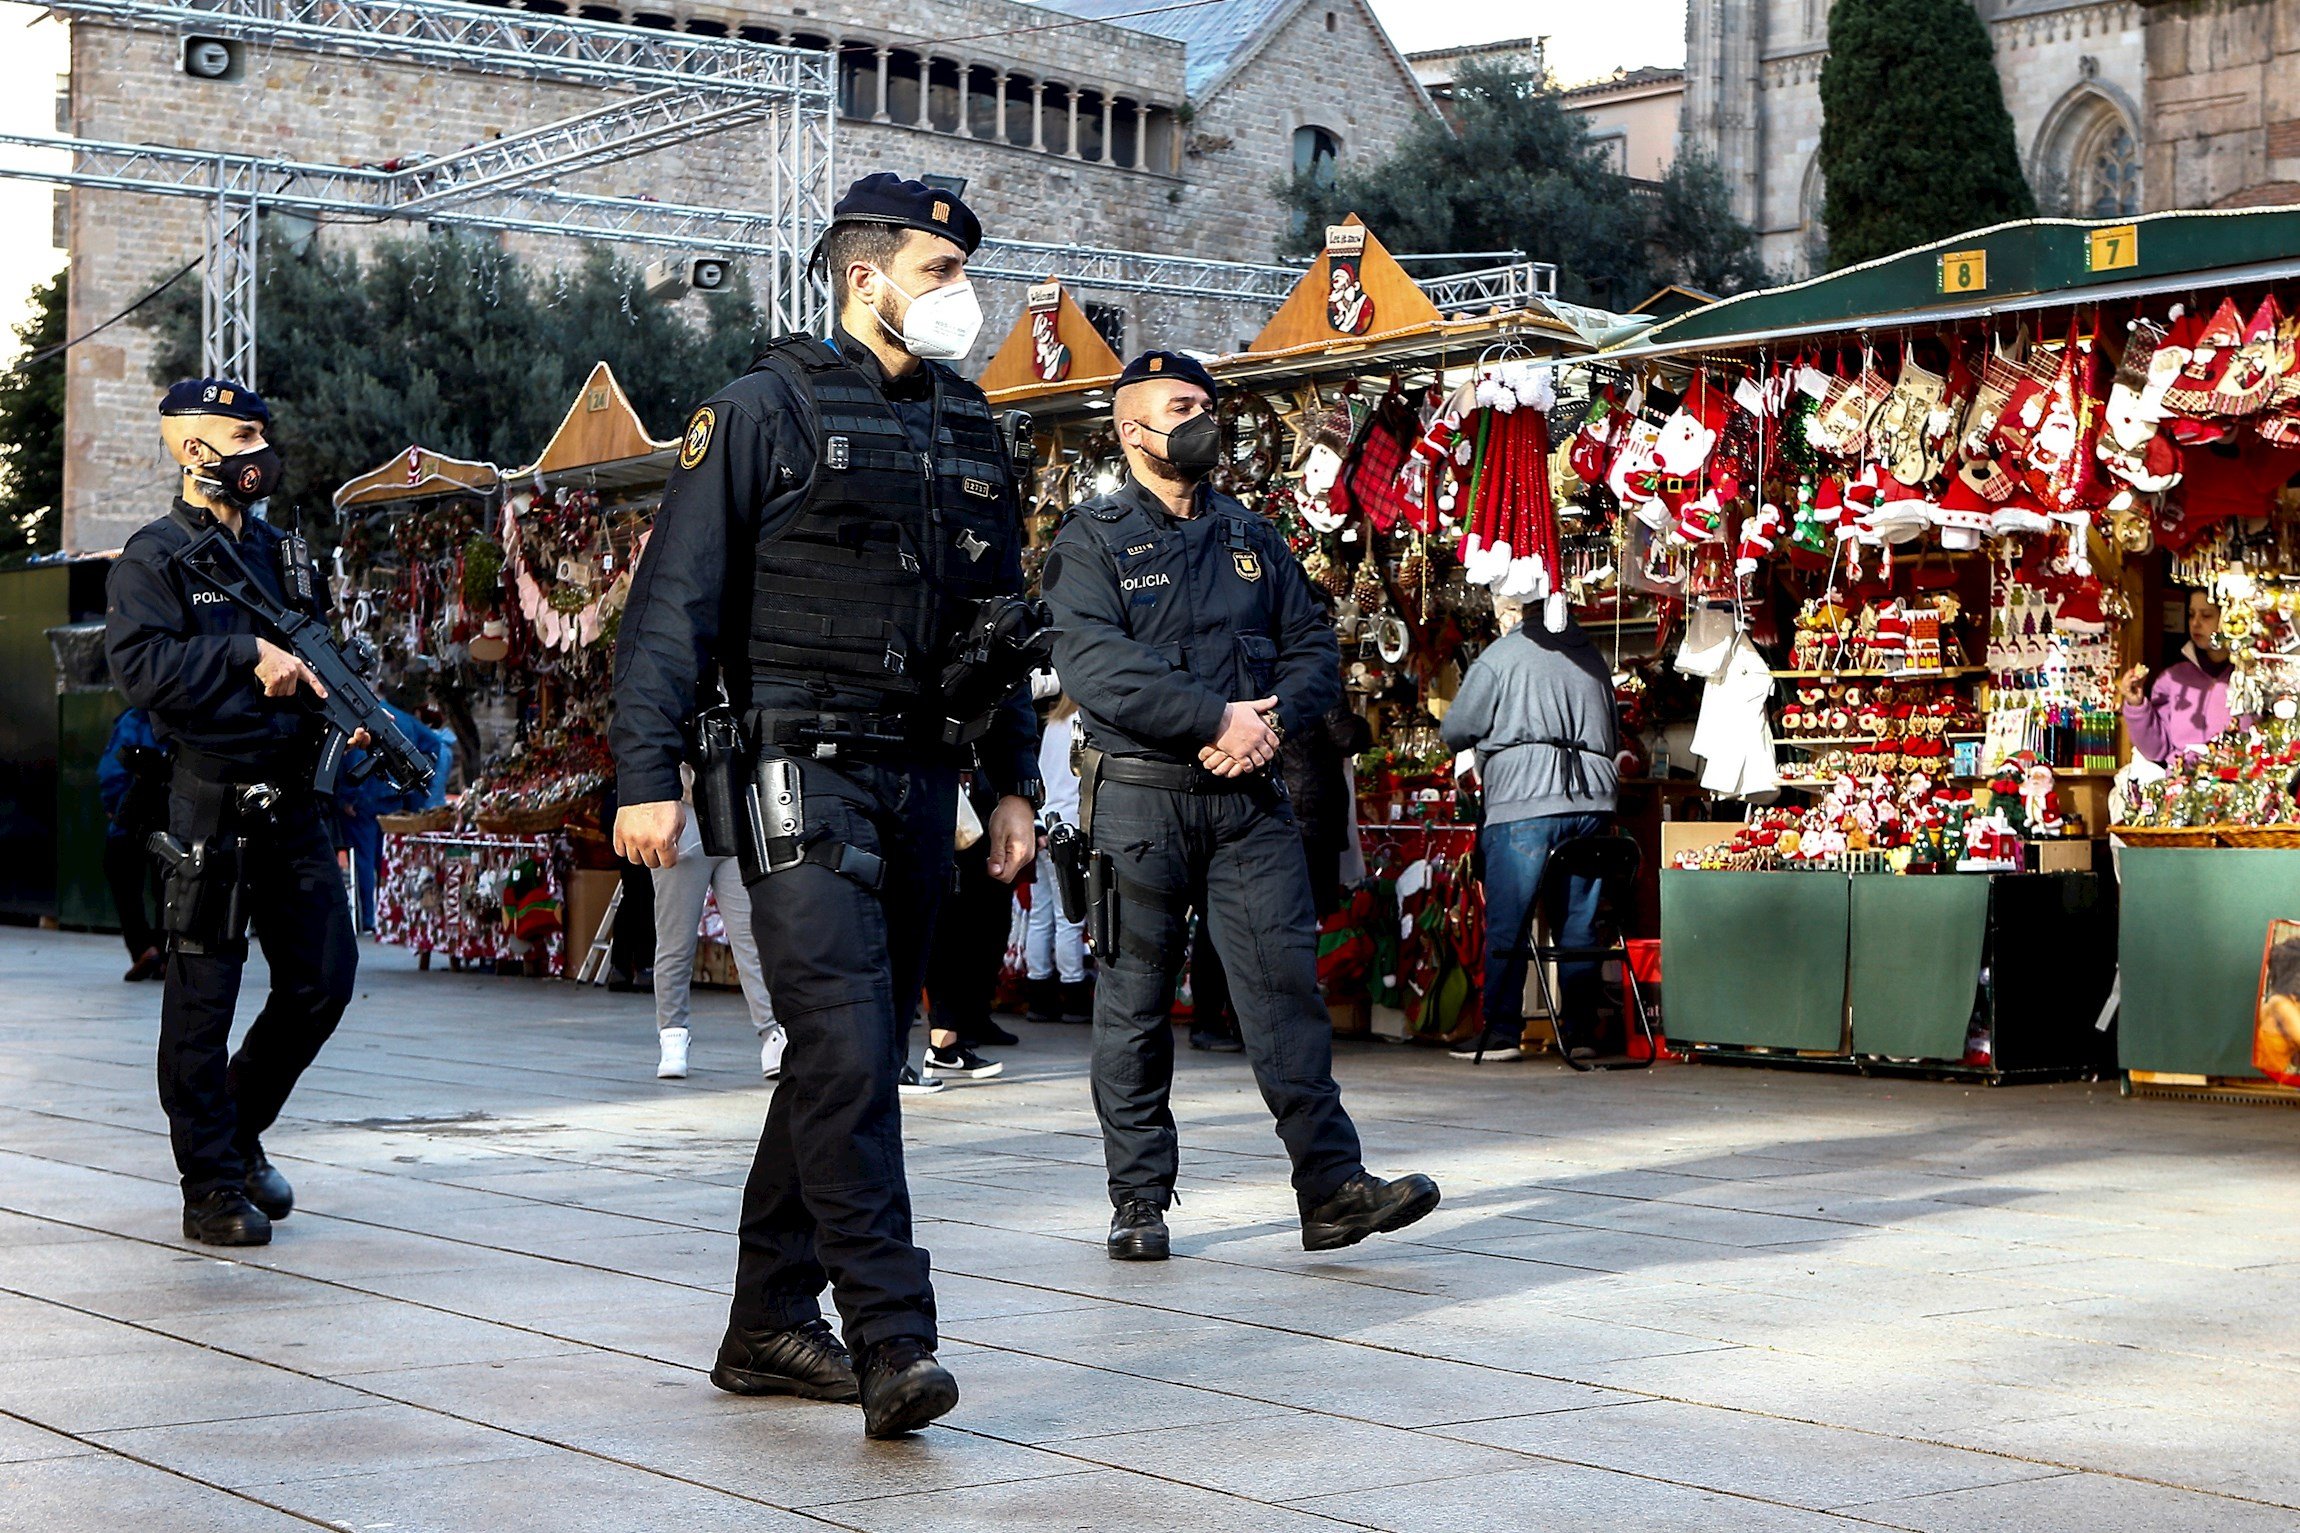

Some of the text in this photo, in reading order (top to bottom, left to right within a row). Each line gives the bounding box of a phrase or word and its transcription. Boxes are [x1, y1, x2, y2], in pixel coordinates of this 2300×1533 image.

[2106, 239, 2119, 265] 7
[1958, 263, 1971, 288] 8
[192, 591, 230, 605] POLI
